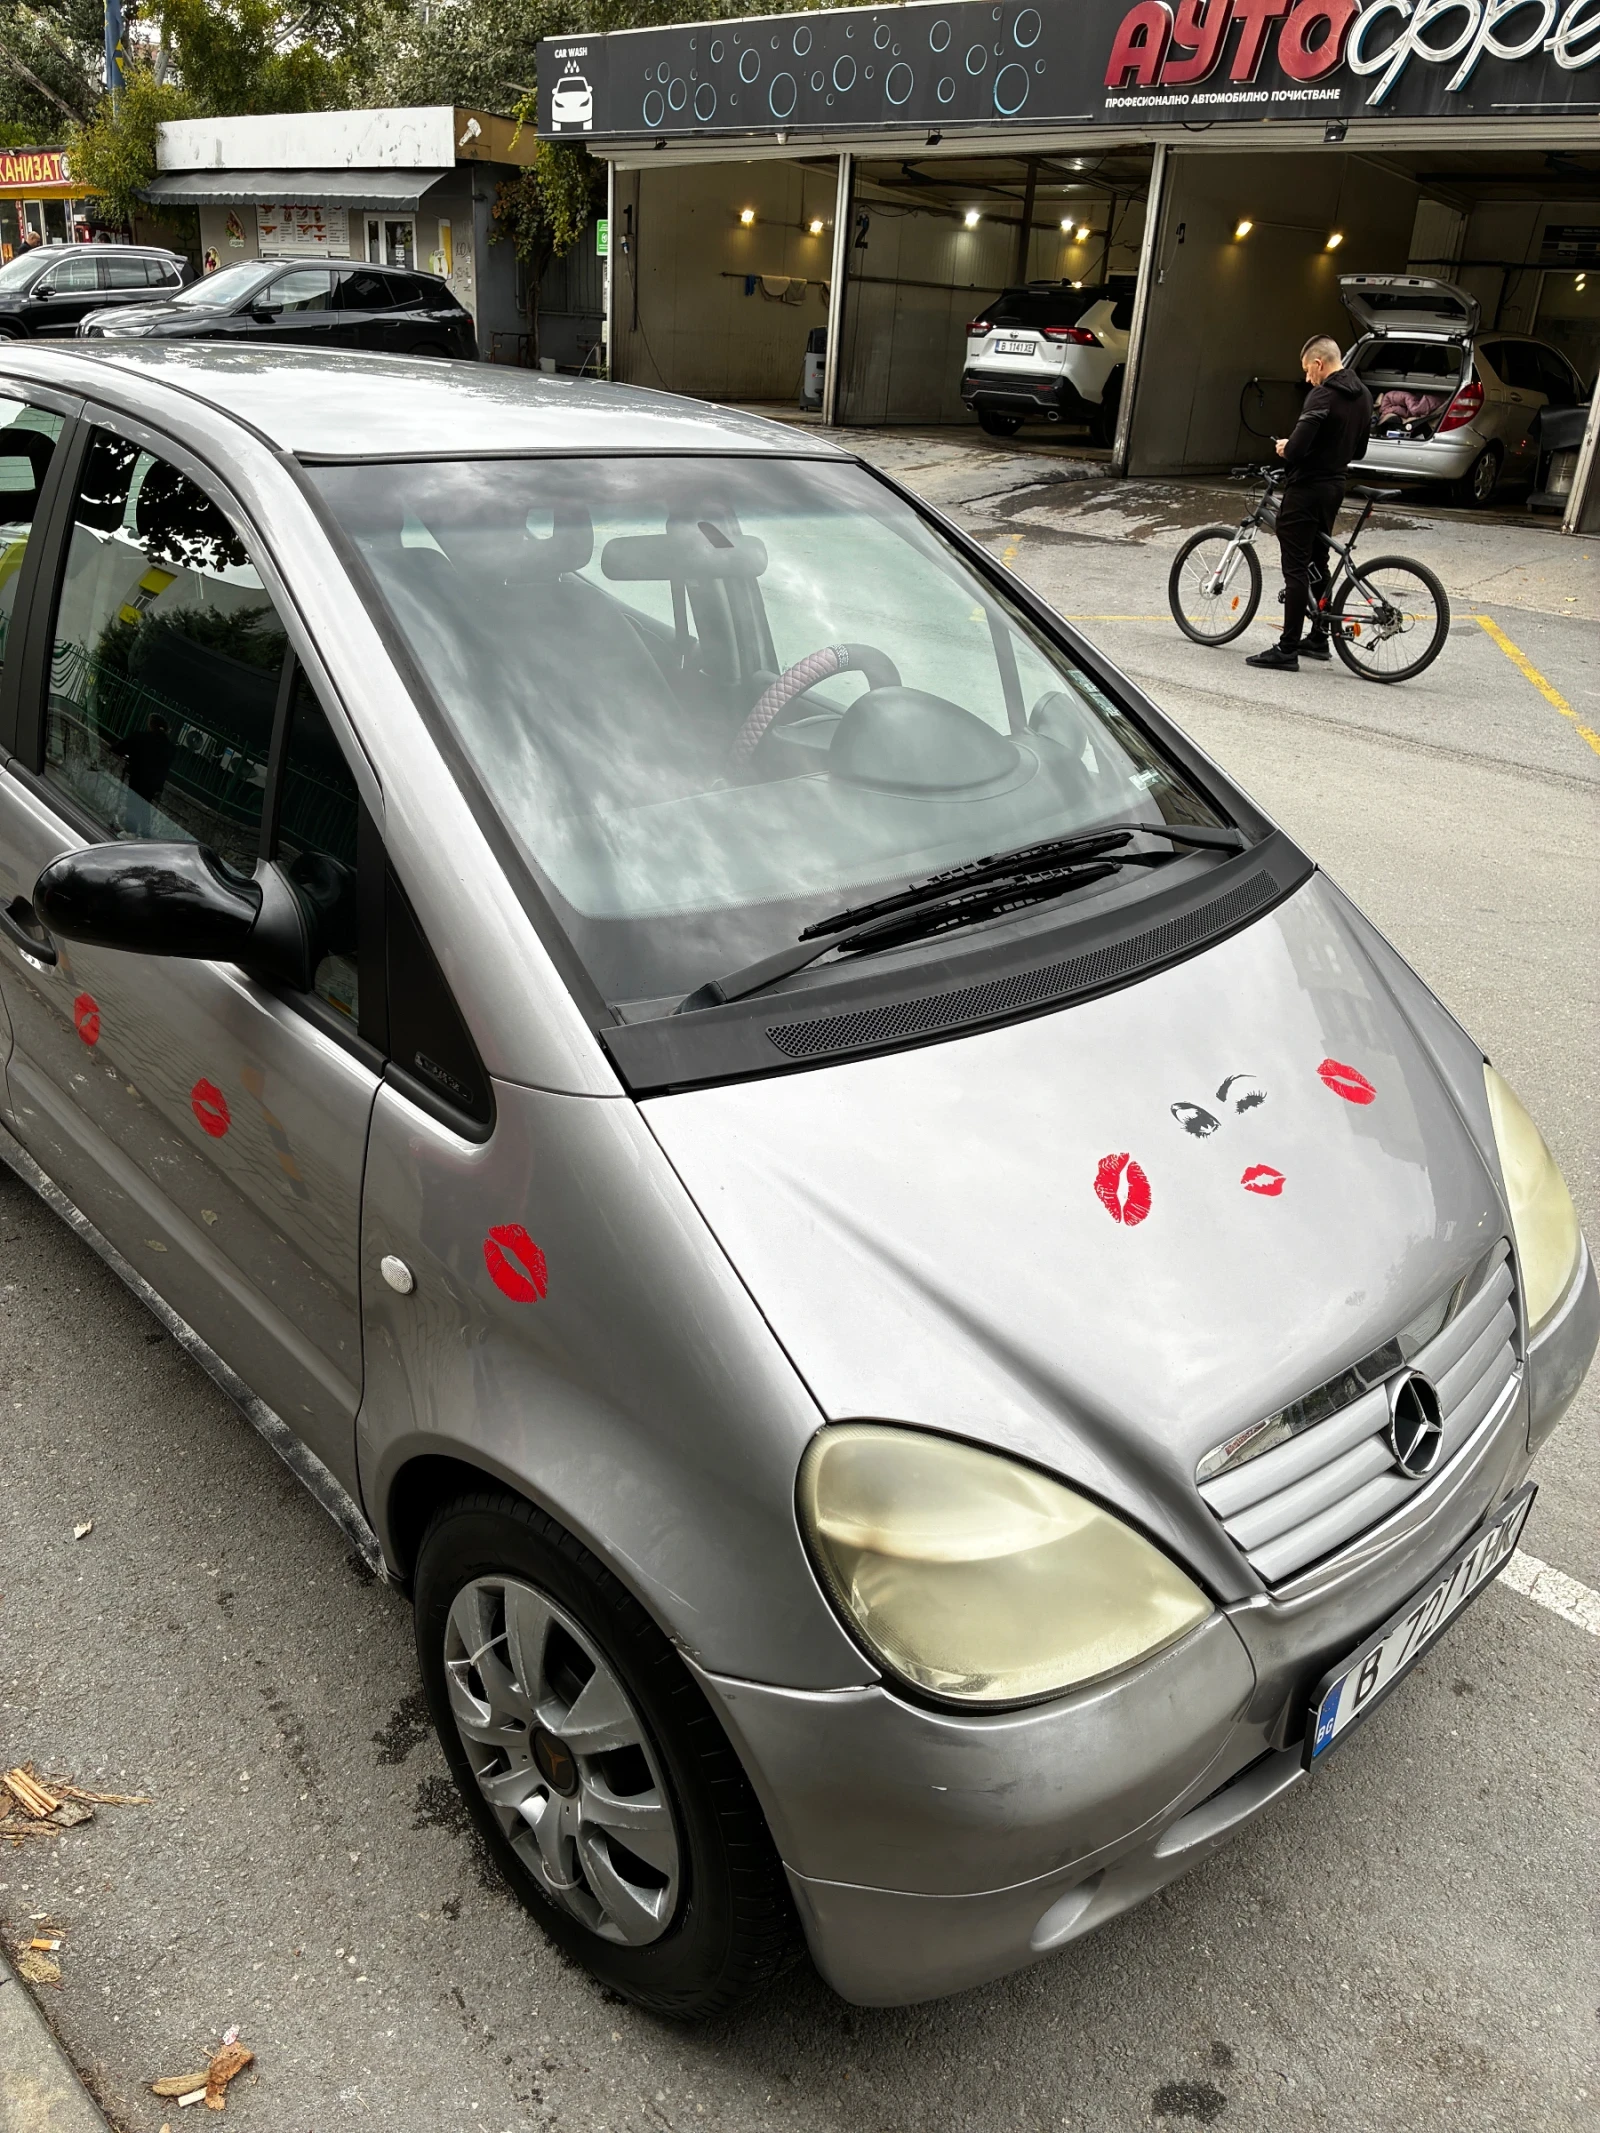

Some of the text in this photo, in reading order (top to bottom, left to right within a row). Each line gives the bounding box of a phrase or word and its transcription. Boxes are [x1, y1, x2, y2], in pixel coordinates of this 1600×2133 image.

[554, 46, 588, 59] CAR WASH
[1104, 88, 1341, 108] ПРОФЕСИОНАЛНО АВТОМОБИЛНО ПОЧИСТВАНЕ
[1351, 1501, 1526, 1711] B 7271 HK
[1316, 1717, 1335, 1745] BG
